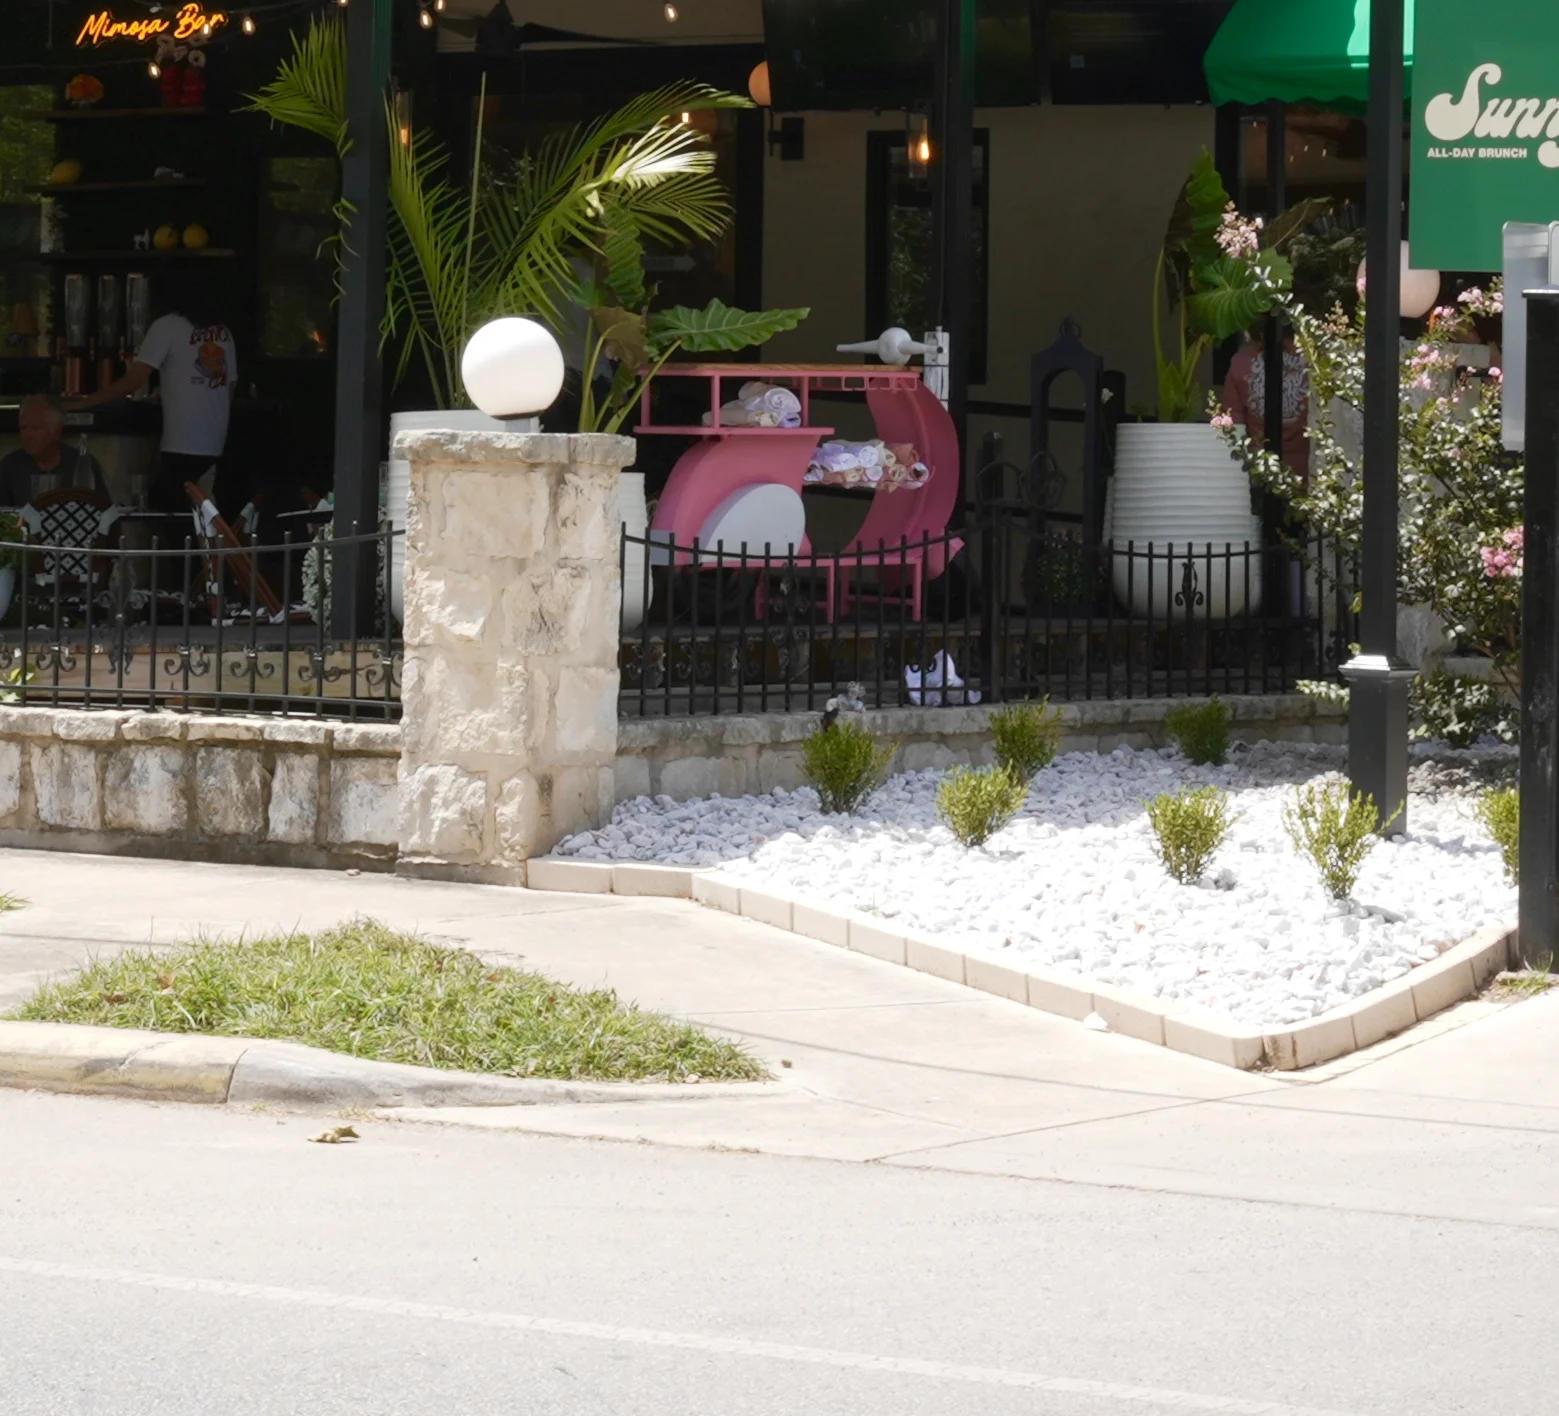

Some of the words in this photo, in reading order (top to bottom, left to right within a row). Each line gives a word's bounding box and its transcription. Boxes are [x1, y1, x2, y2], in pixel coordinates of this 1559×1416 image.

[76, 10, 170, 46] Mimosa
[173, 2, 227, 39] Bar
[1427, 147, 1476, 159] ALL-DAY
[1478, 147, 1528, 159] BRUNCH
